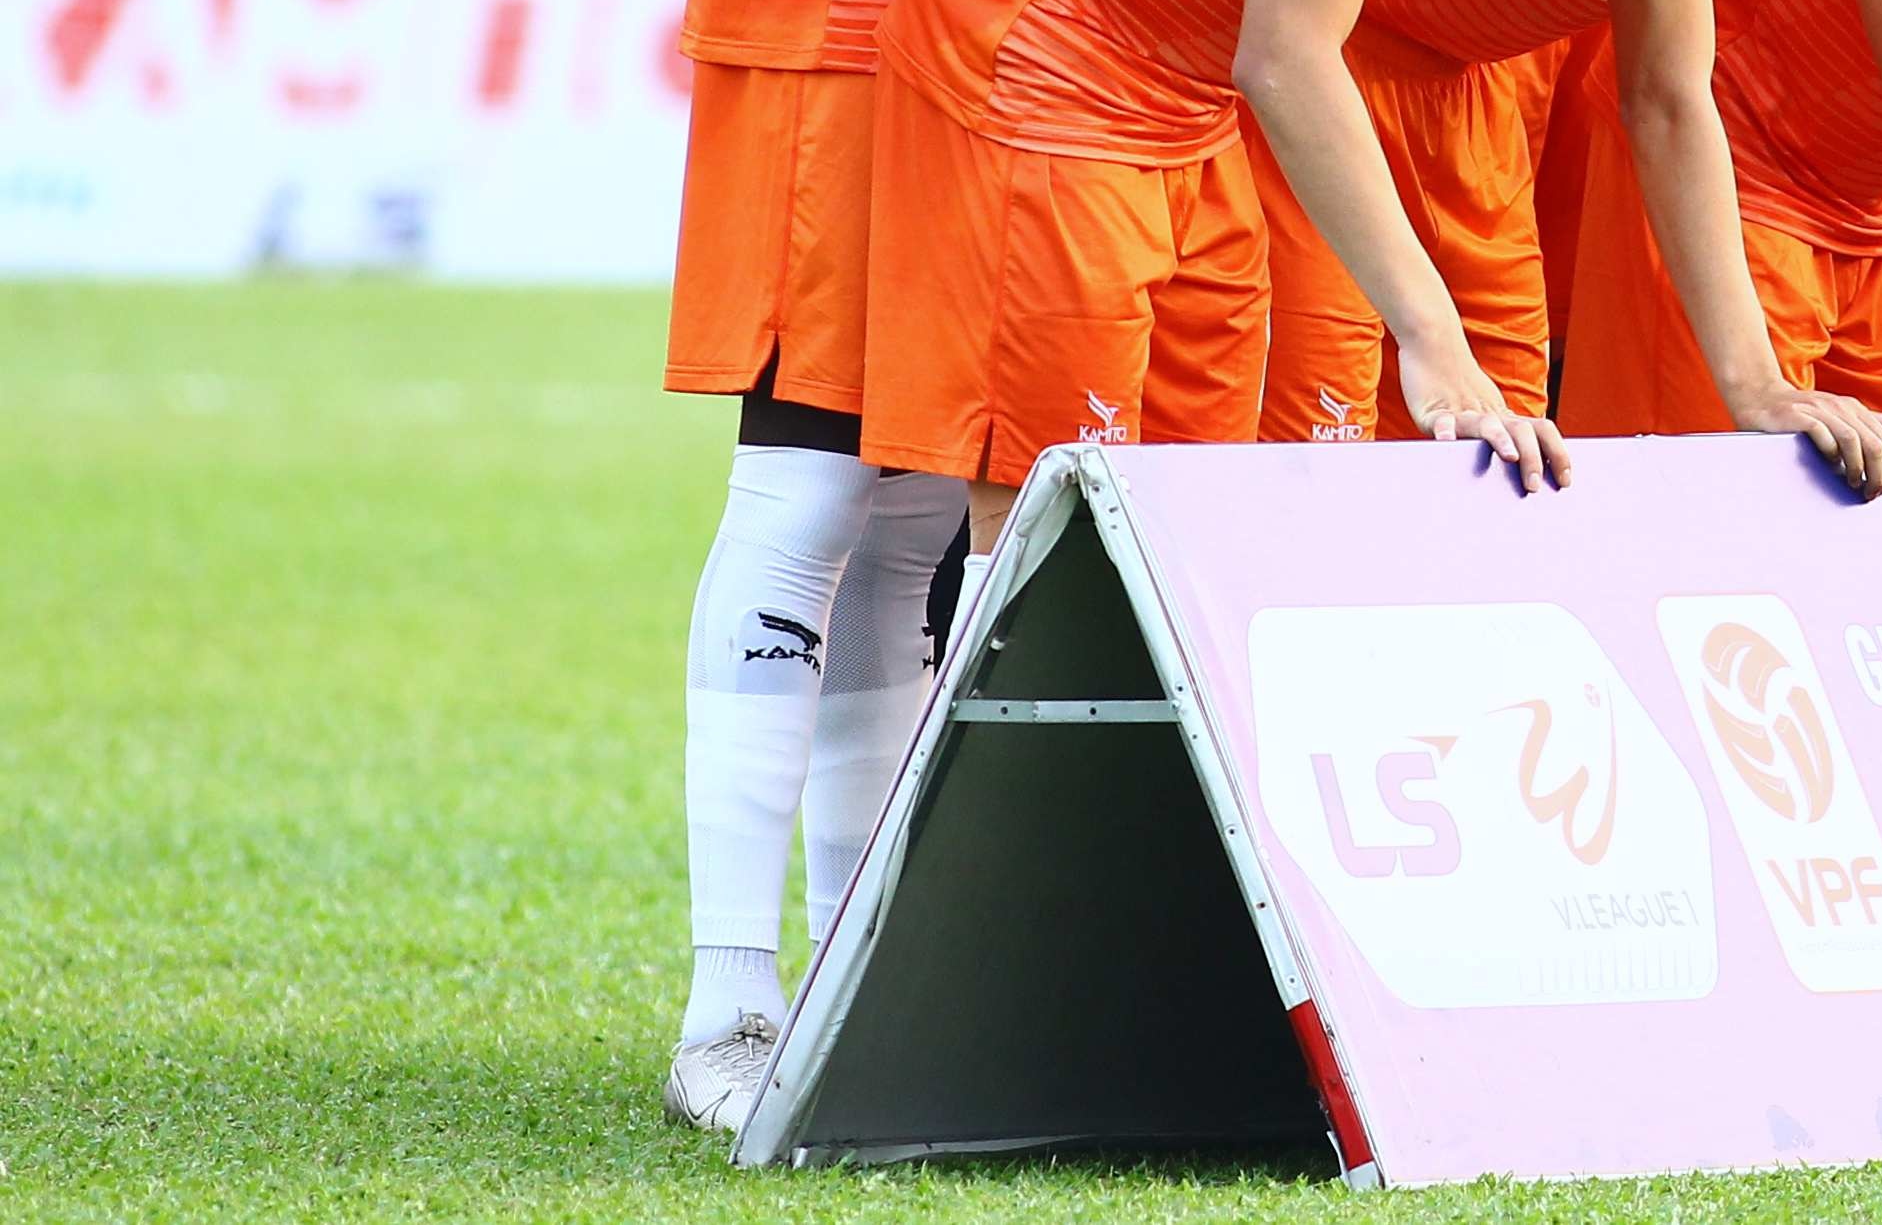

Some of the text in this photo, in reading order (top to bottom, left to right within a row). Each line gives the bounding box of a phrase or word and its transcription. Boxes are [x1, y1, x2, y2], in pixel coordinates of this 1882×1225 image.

[1079, 425, 1127, 442] KAMITO
[1312, 424, 1365, 441] KAMITO
[1309, 752, 1462, 879] LS
